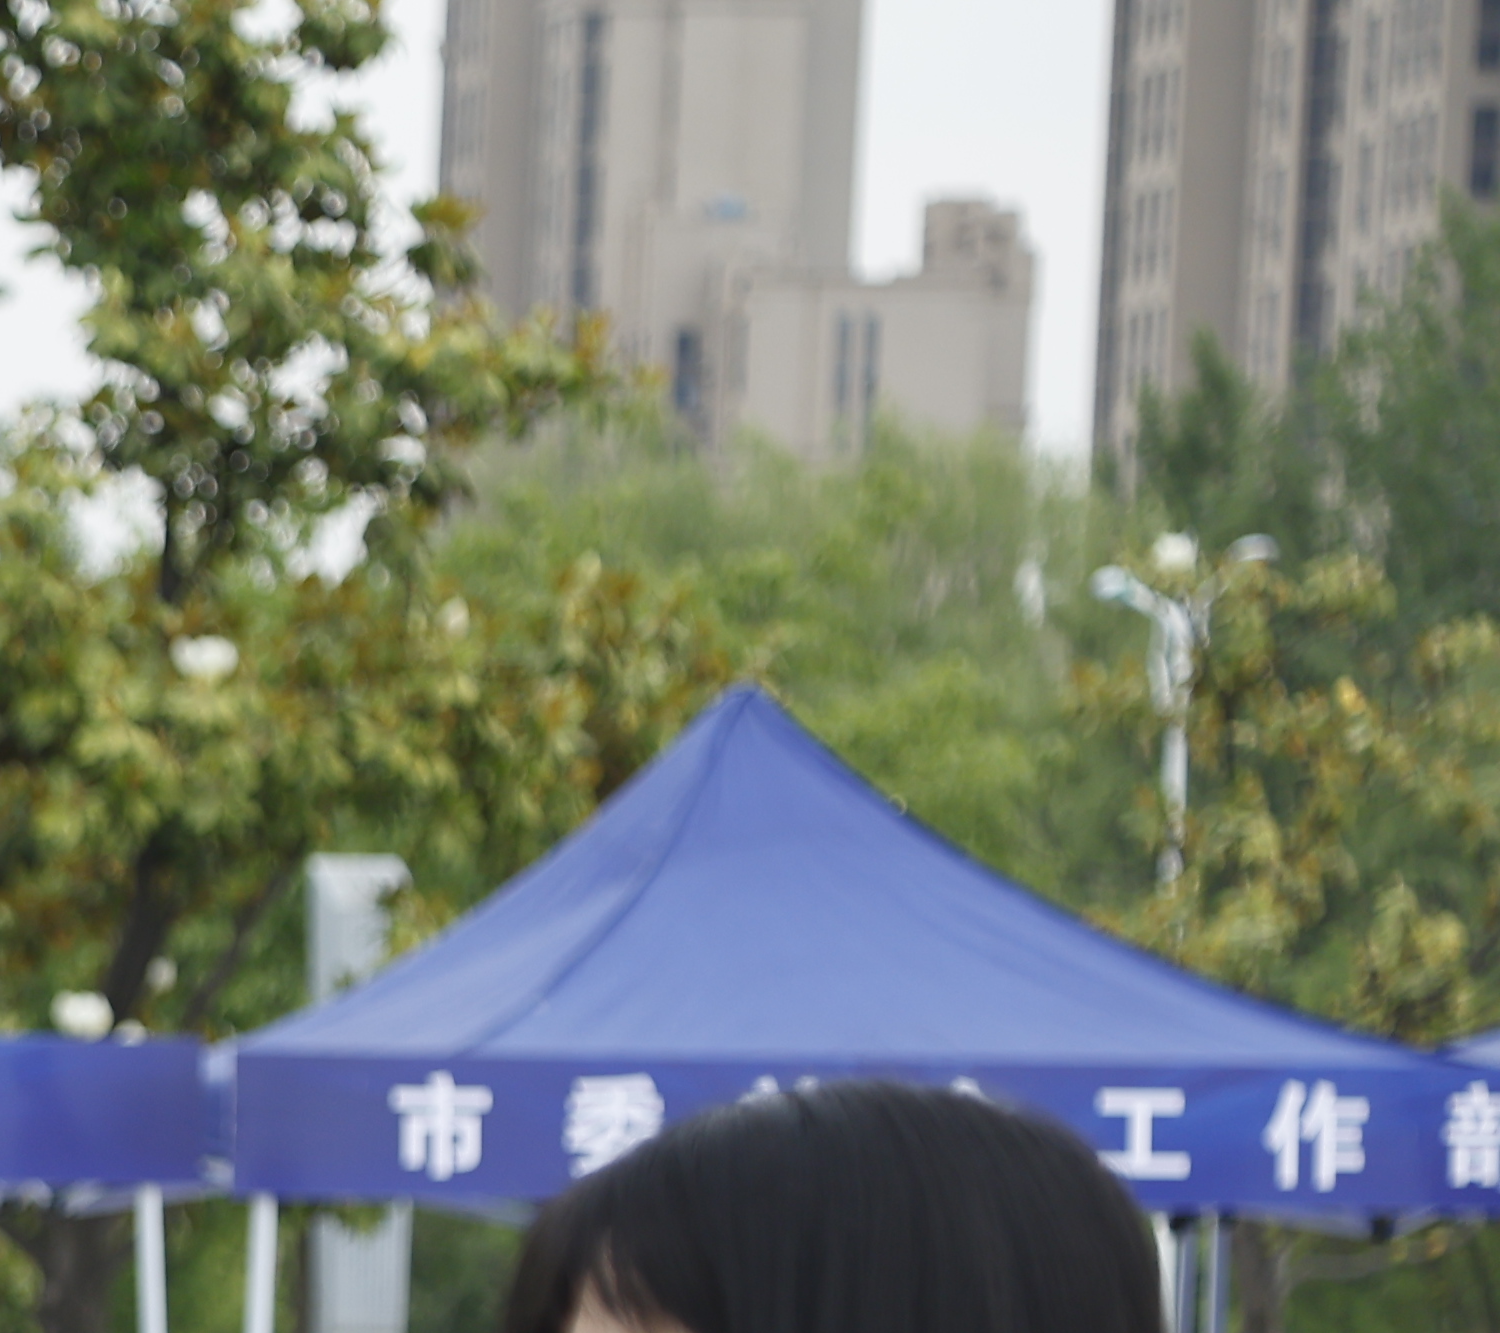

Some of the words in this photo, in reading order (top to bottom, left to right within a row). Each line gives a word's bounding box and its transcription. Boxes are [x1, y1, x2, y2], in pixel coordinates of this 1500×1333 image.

[386, 1070, 1500, 1192] 市委工作部
